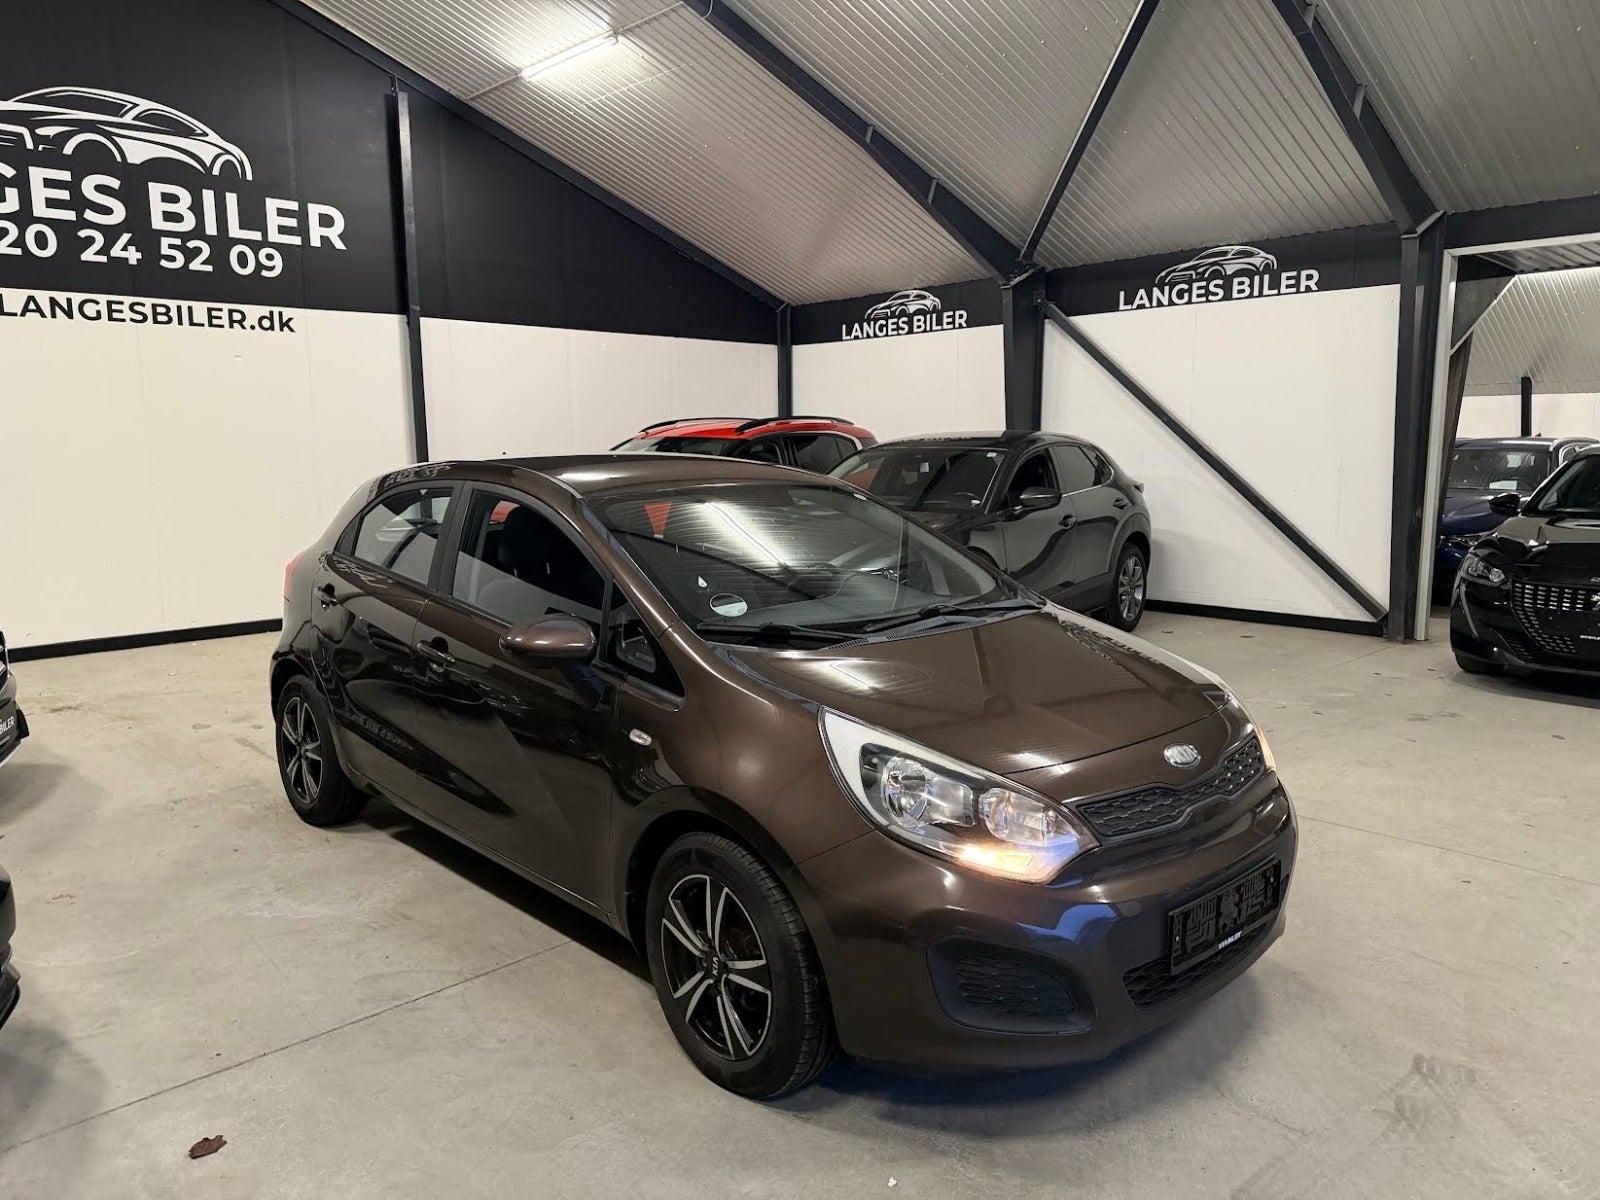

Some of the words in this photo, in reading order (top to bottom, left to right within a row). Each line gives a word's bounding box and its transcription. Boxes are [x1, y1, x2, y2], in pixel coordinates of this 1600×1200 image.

[148, 182, 347, 250] BILER
[0, 220, 58, 257] 20
[77, 229, 142, 264] 24
[160, 237, 214, 271] 52
[230, 245, 283, 278] 09
[1118, 279, 1224, 311] LANGES
[1232, 269, 1320, 299] BILER
[0, 294, 295, 333] LANGESBILER.dk
[842, 316, 909, 341] LANGES
[912, 309, 968, 333] BILER
